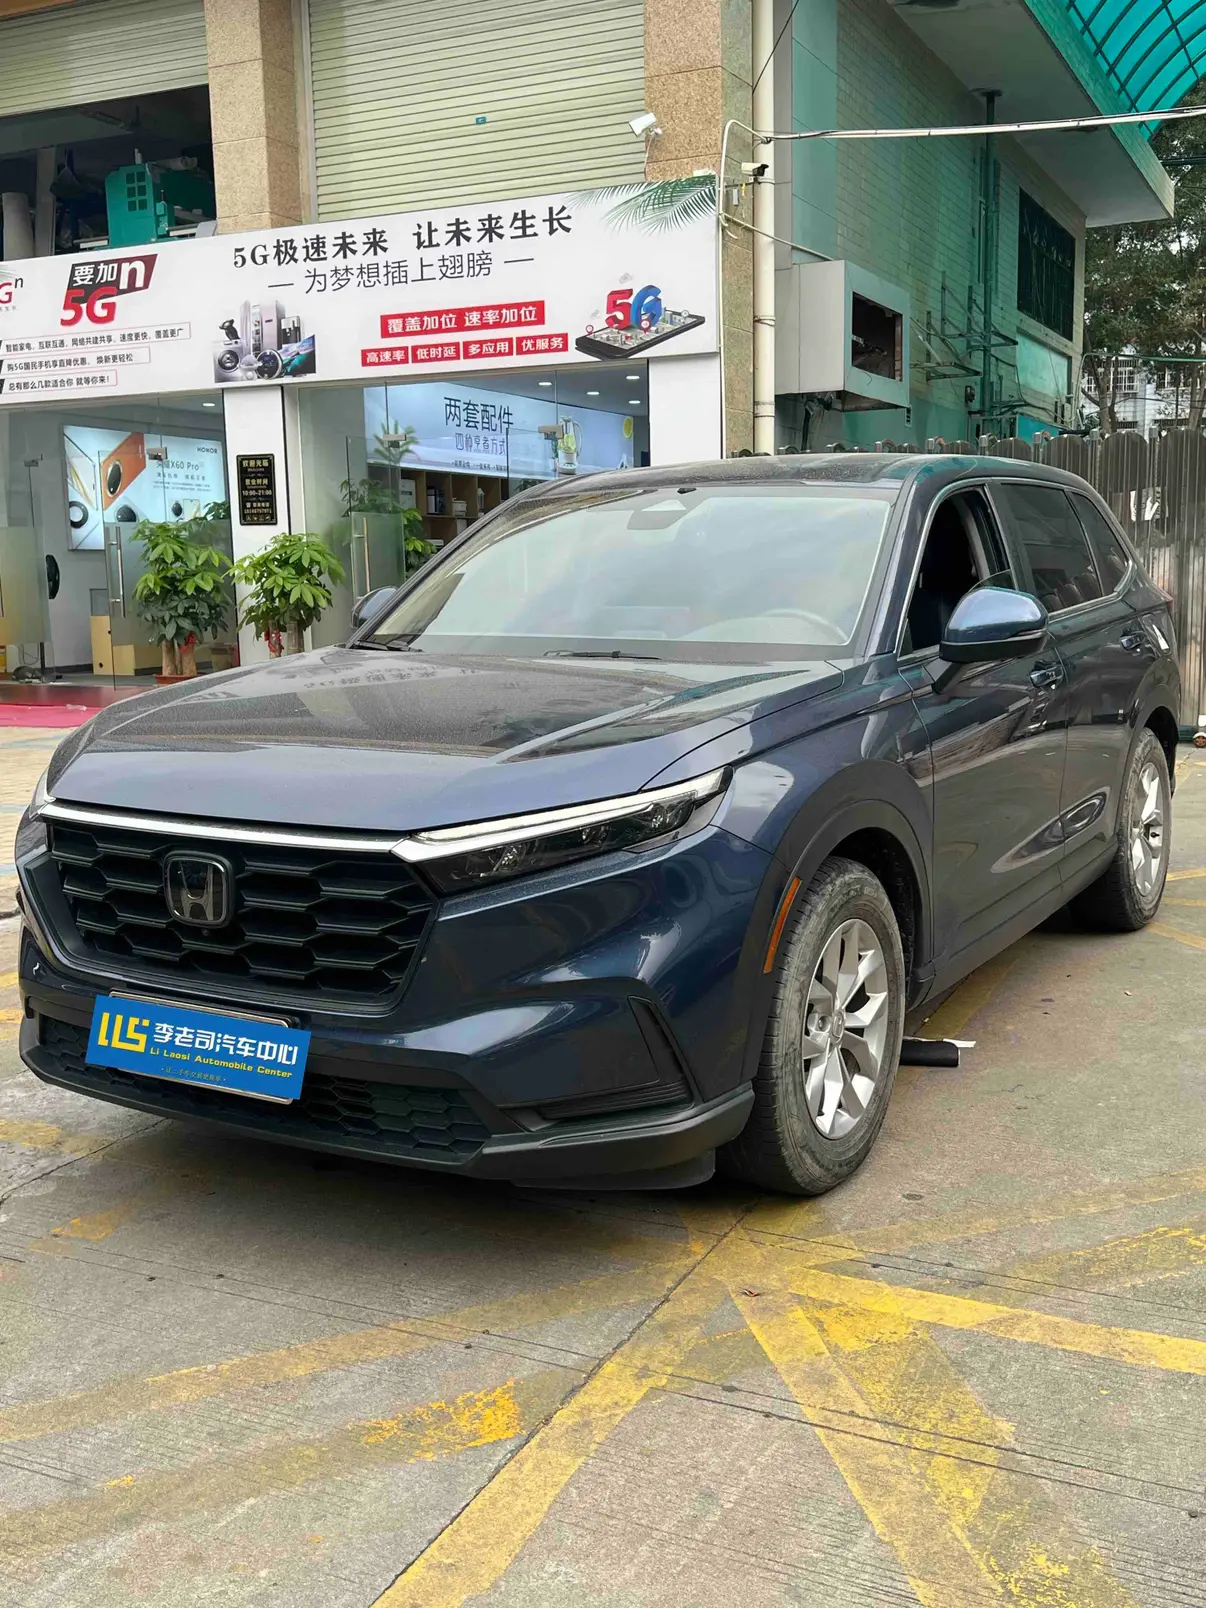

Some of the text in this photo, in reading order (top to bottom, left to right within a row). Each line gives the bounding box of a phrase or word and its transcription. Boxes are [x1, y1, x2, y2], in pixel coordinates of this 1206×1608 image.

[234, 205, 573, 268] 5G极速未来 让未来生长
[304, 250, 493, 294] 为梦想插上翅膀
[60, 286, 118, 326] 5G
[387, 306, 538, 334] 覆盖加位 速率加位
[605, 284, 663, 331] 5G
[366, 348, 406, 363] 高速率
[416, 344, 457, 360] 低时延
[468, 340, 509, 356] 多应用
[521, 336, 565, 352] 优服务
[443, 396, 514, 433] 两套配件
[153, 1022, 298, 1066] 李老司汽车中心
[150, 1047, 292, 1079] Li Laosi Automobile Center
